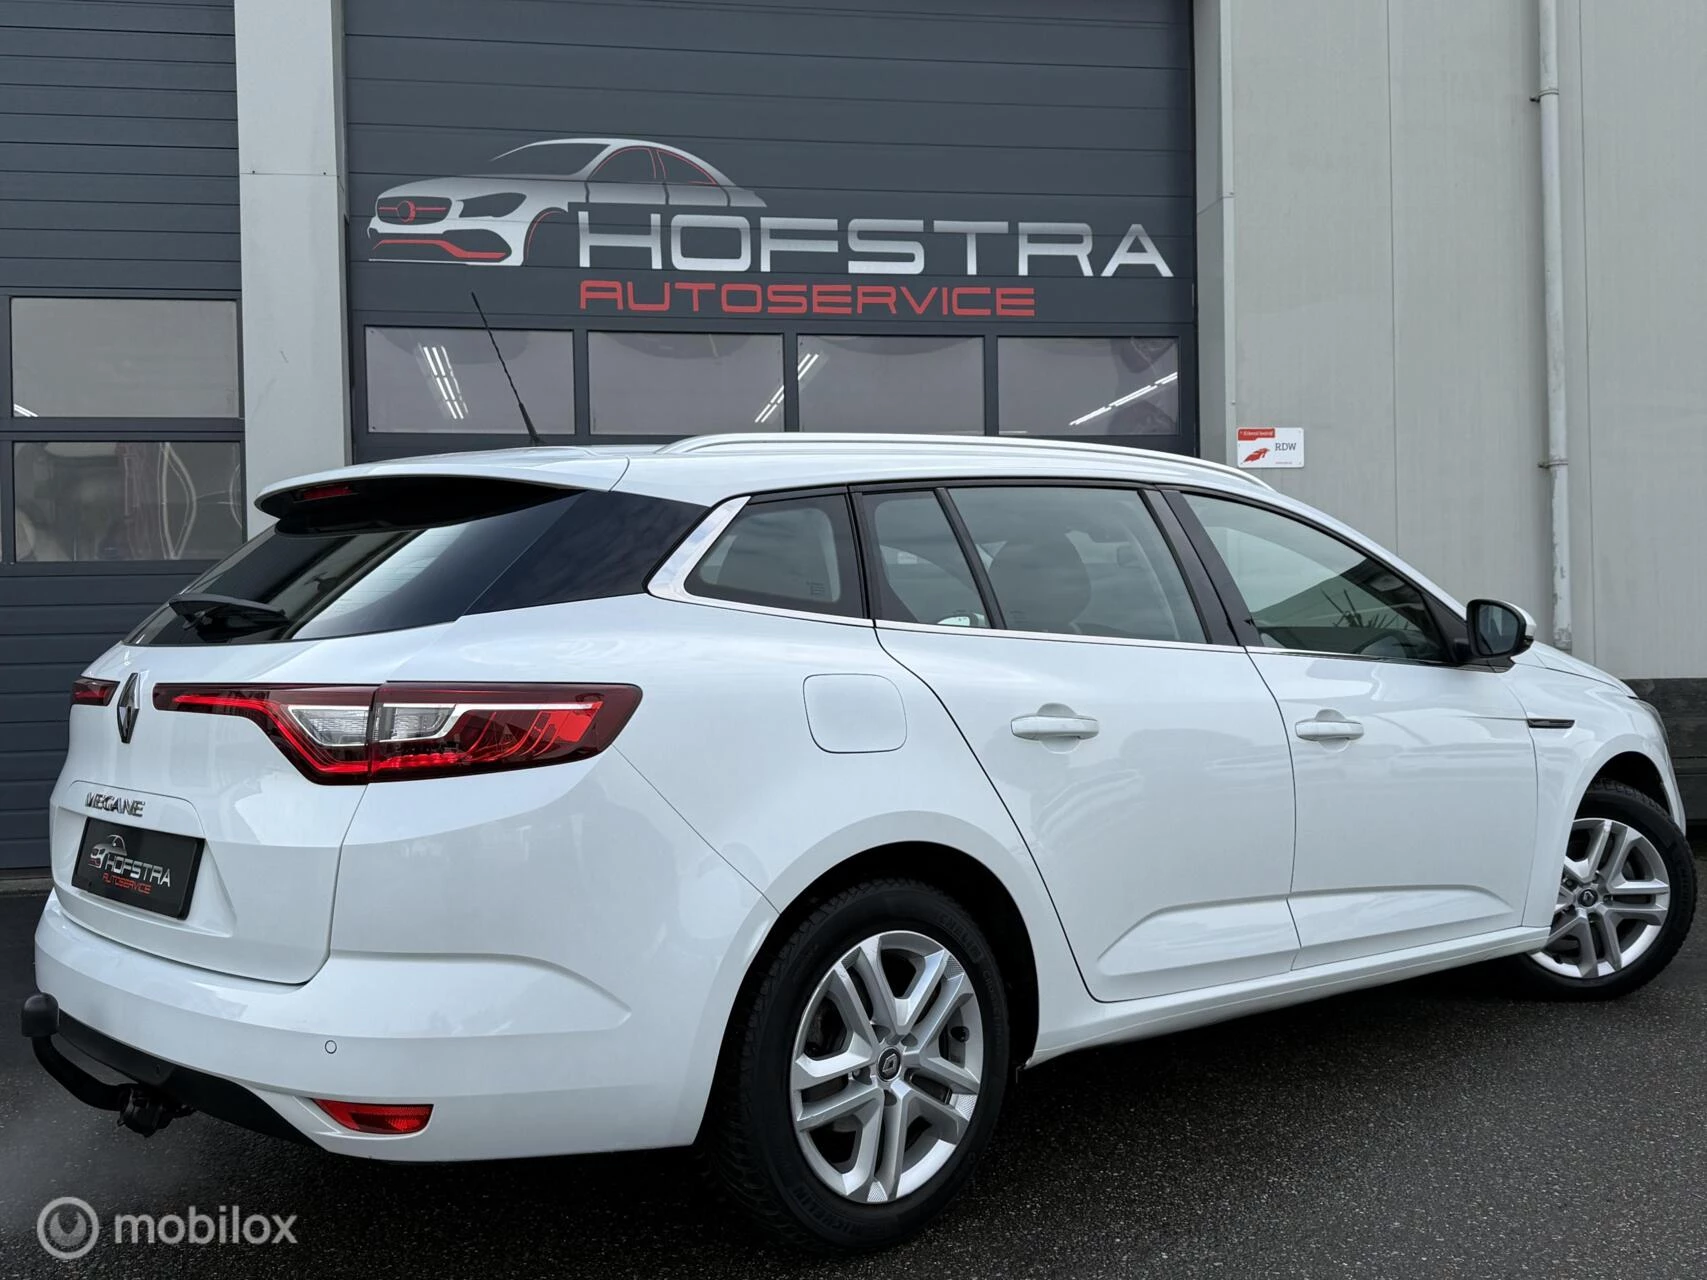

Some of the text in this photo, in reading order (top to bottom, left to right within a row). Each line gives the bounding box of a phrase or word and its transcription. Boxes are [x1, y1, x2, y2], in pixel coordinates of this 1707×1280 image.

[577, 210, 1174, 278] HOFSTRA
[579, 280, 1035, 317] AUTOSERVICE
[1275, 442, 1296, 451] RDW
[86, 792, 145, 817] MEGANE
[102, 872, 151, 894] AUTOSERVICE
[104, 853, 171, 888] HOFSTRA
